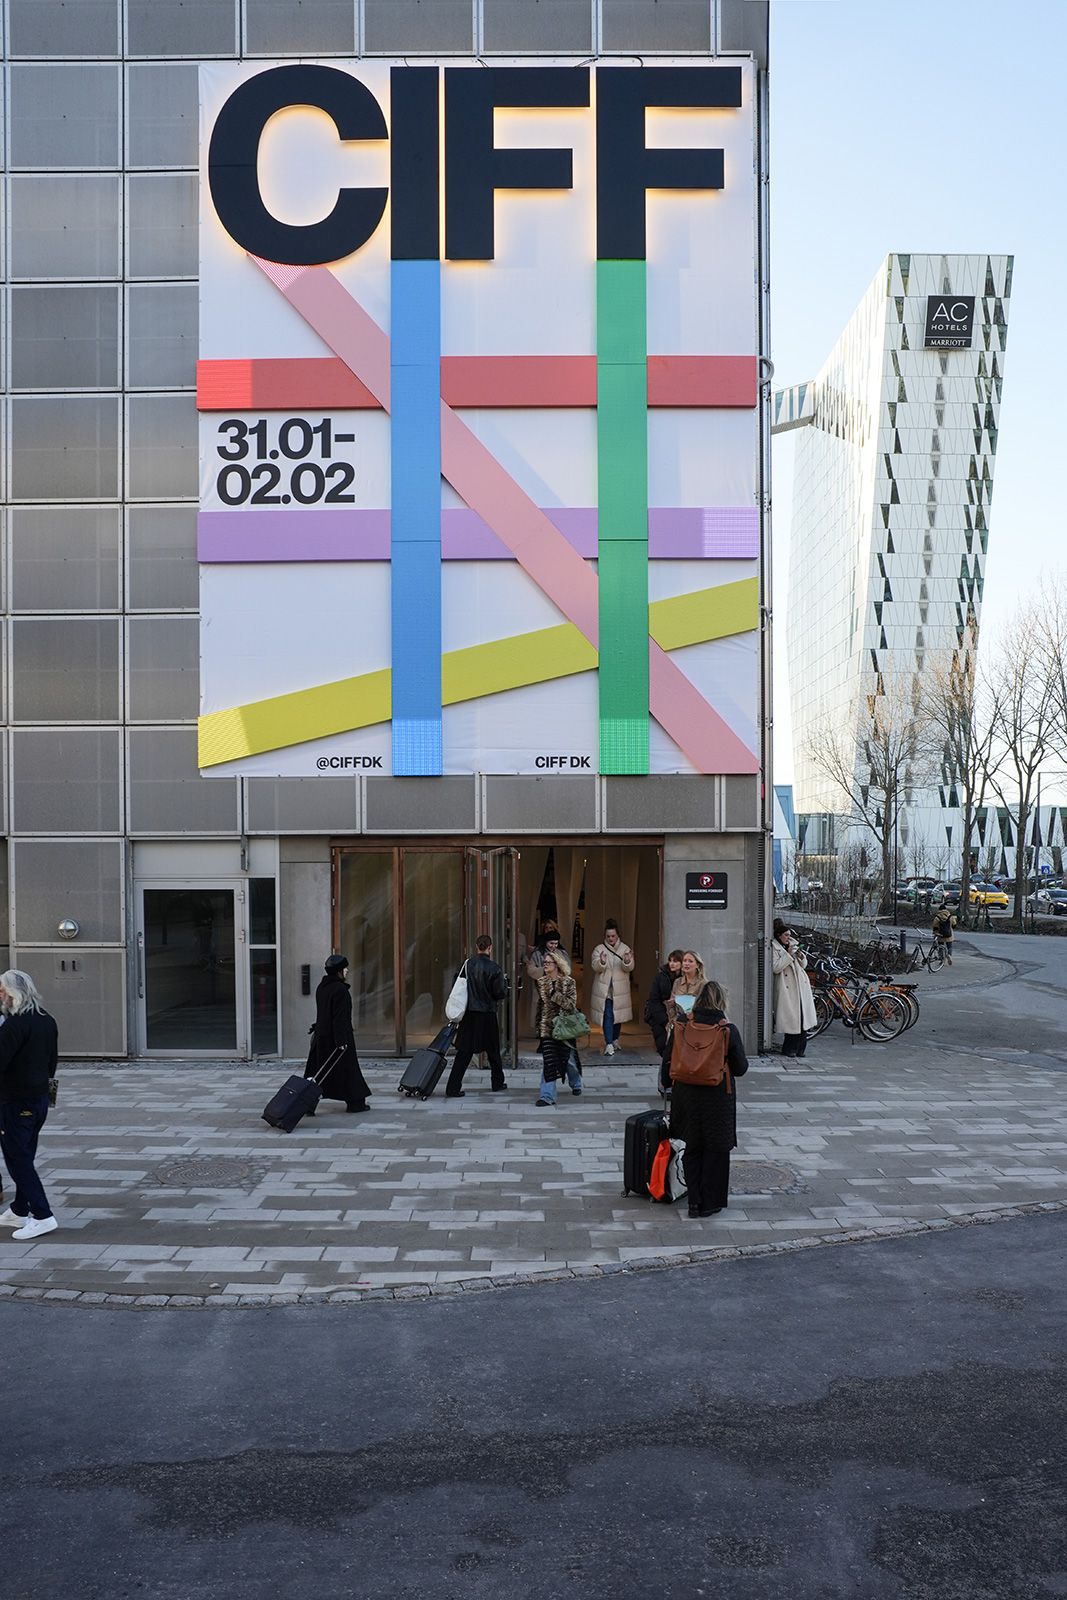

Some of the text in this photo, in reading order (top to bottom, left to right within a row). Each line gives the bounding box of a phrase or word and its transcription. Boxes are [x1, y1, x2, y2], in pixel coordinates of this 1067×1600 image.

[208, 64, 742, 266] CIFF
[932, 302, 968, 322] AC
[216, 418, 355, 461] 31.01-
[216, 462, 355, 506] 02.02
[316, 756, 383, 770] @CIFFDK
